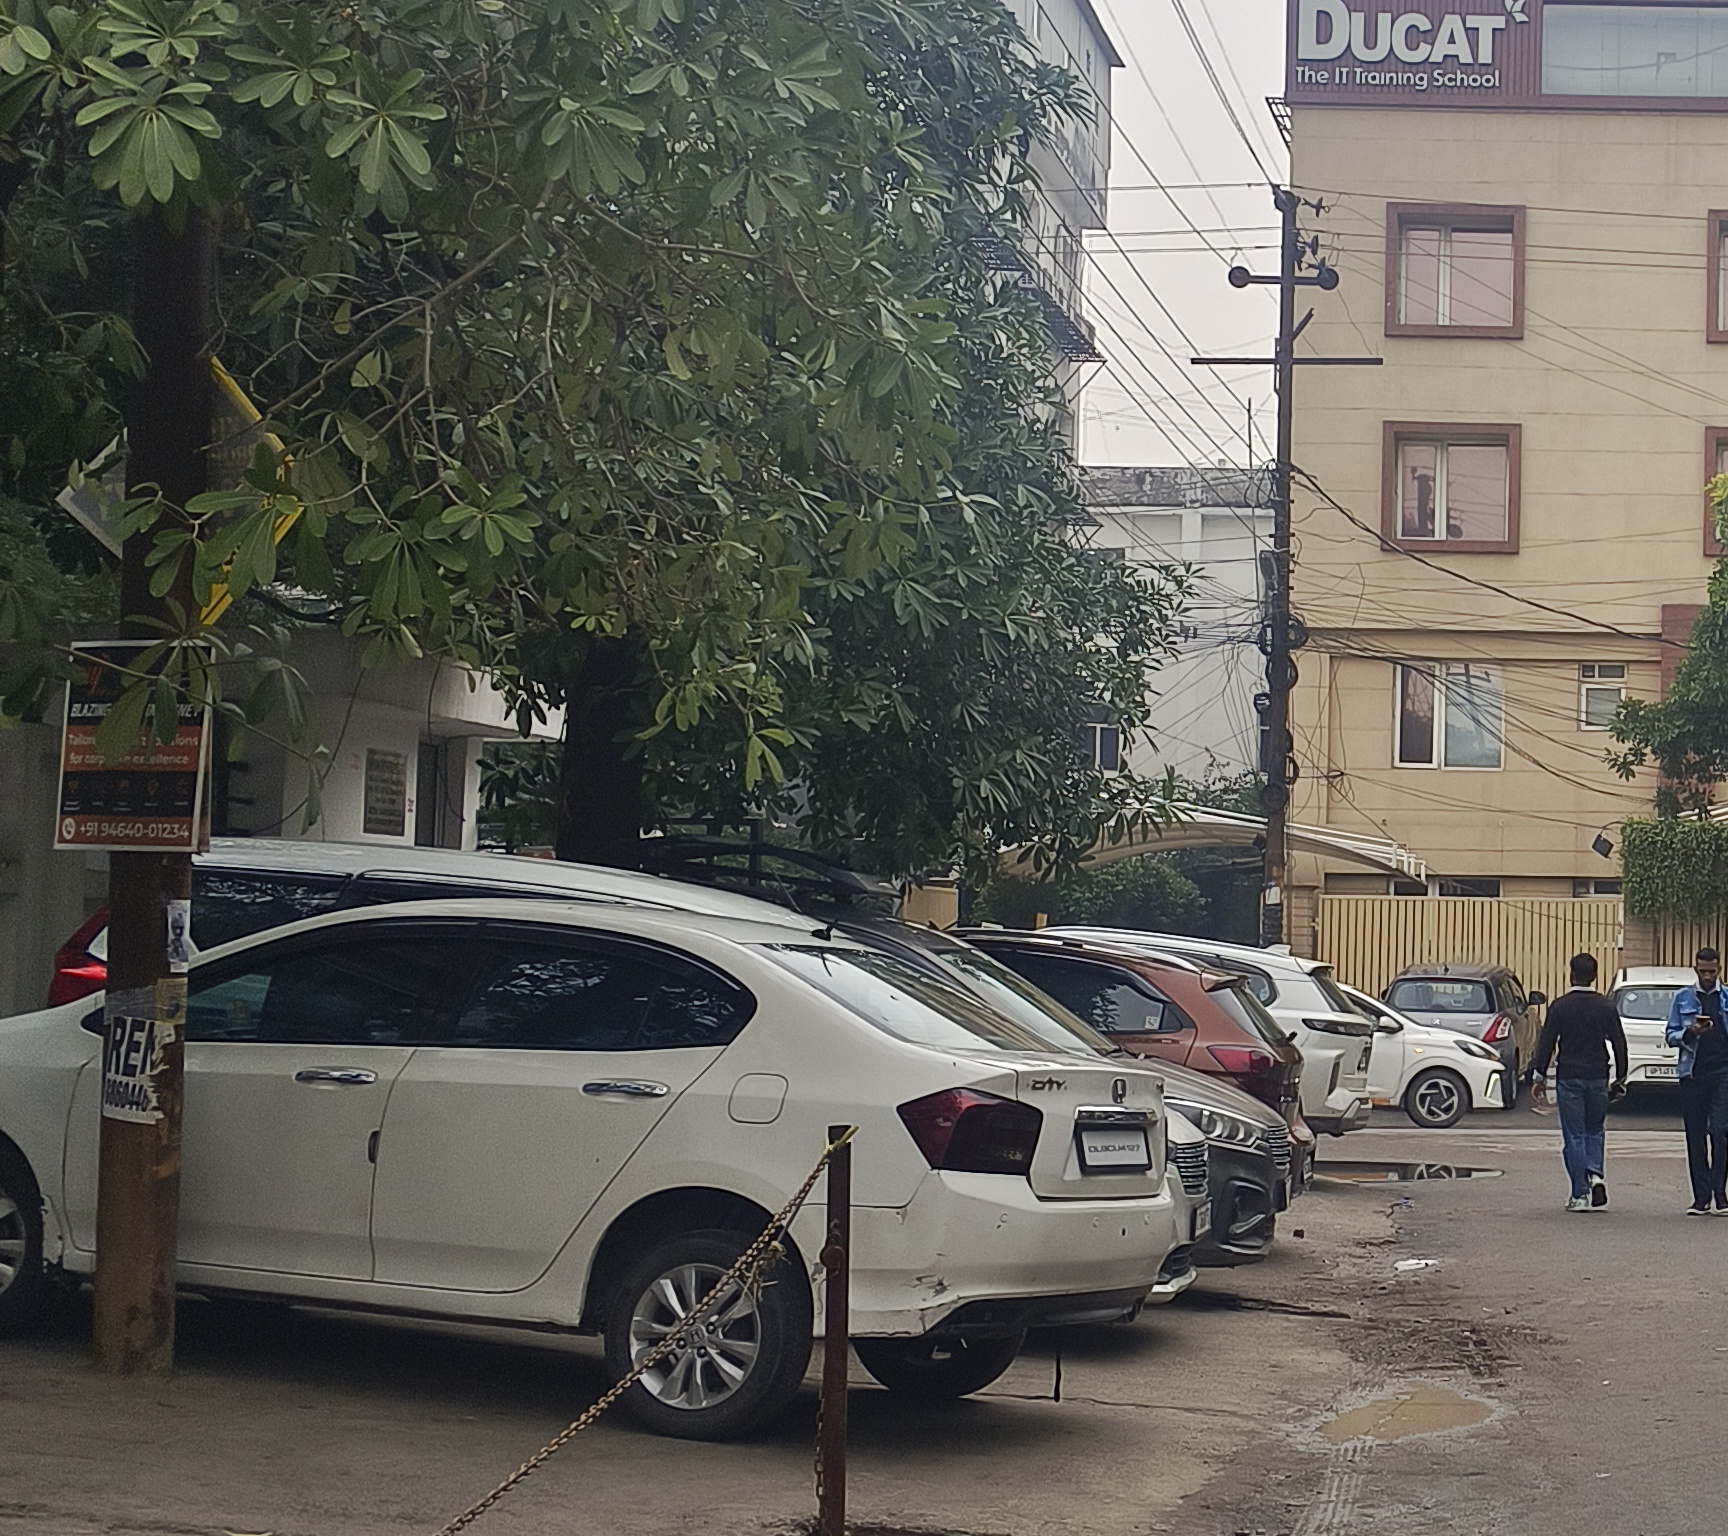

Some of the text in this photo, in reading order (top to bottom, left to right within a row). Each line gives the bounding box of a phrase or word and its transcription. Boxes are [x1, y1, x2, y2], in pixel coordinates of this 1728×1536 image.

[1296, 66, 1500, 91] The IT Training School
